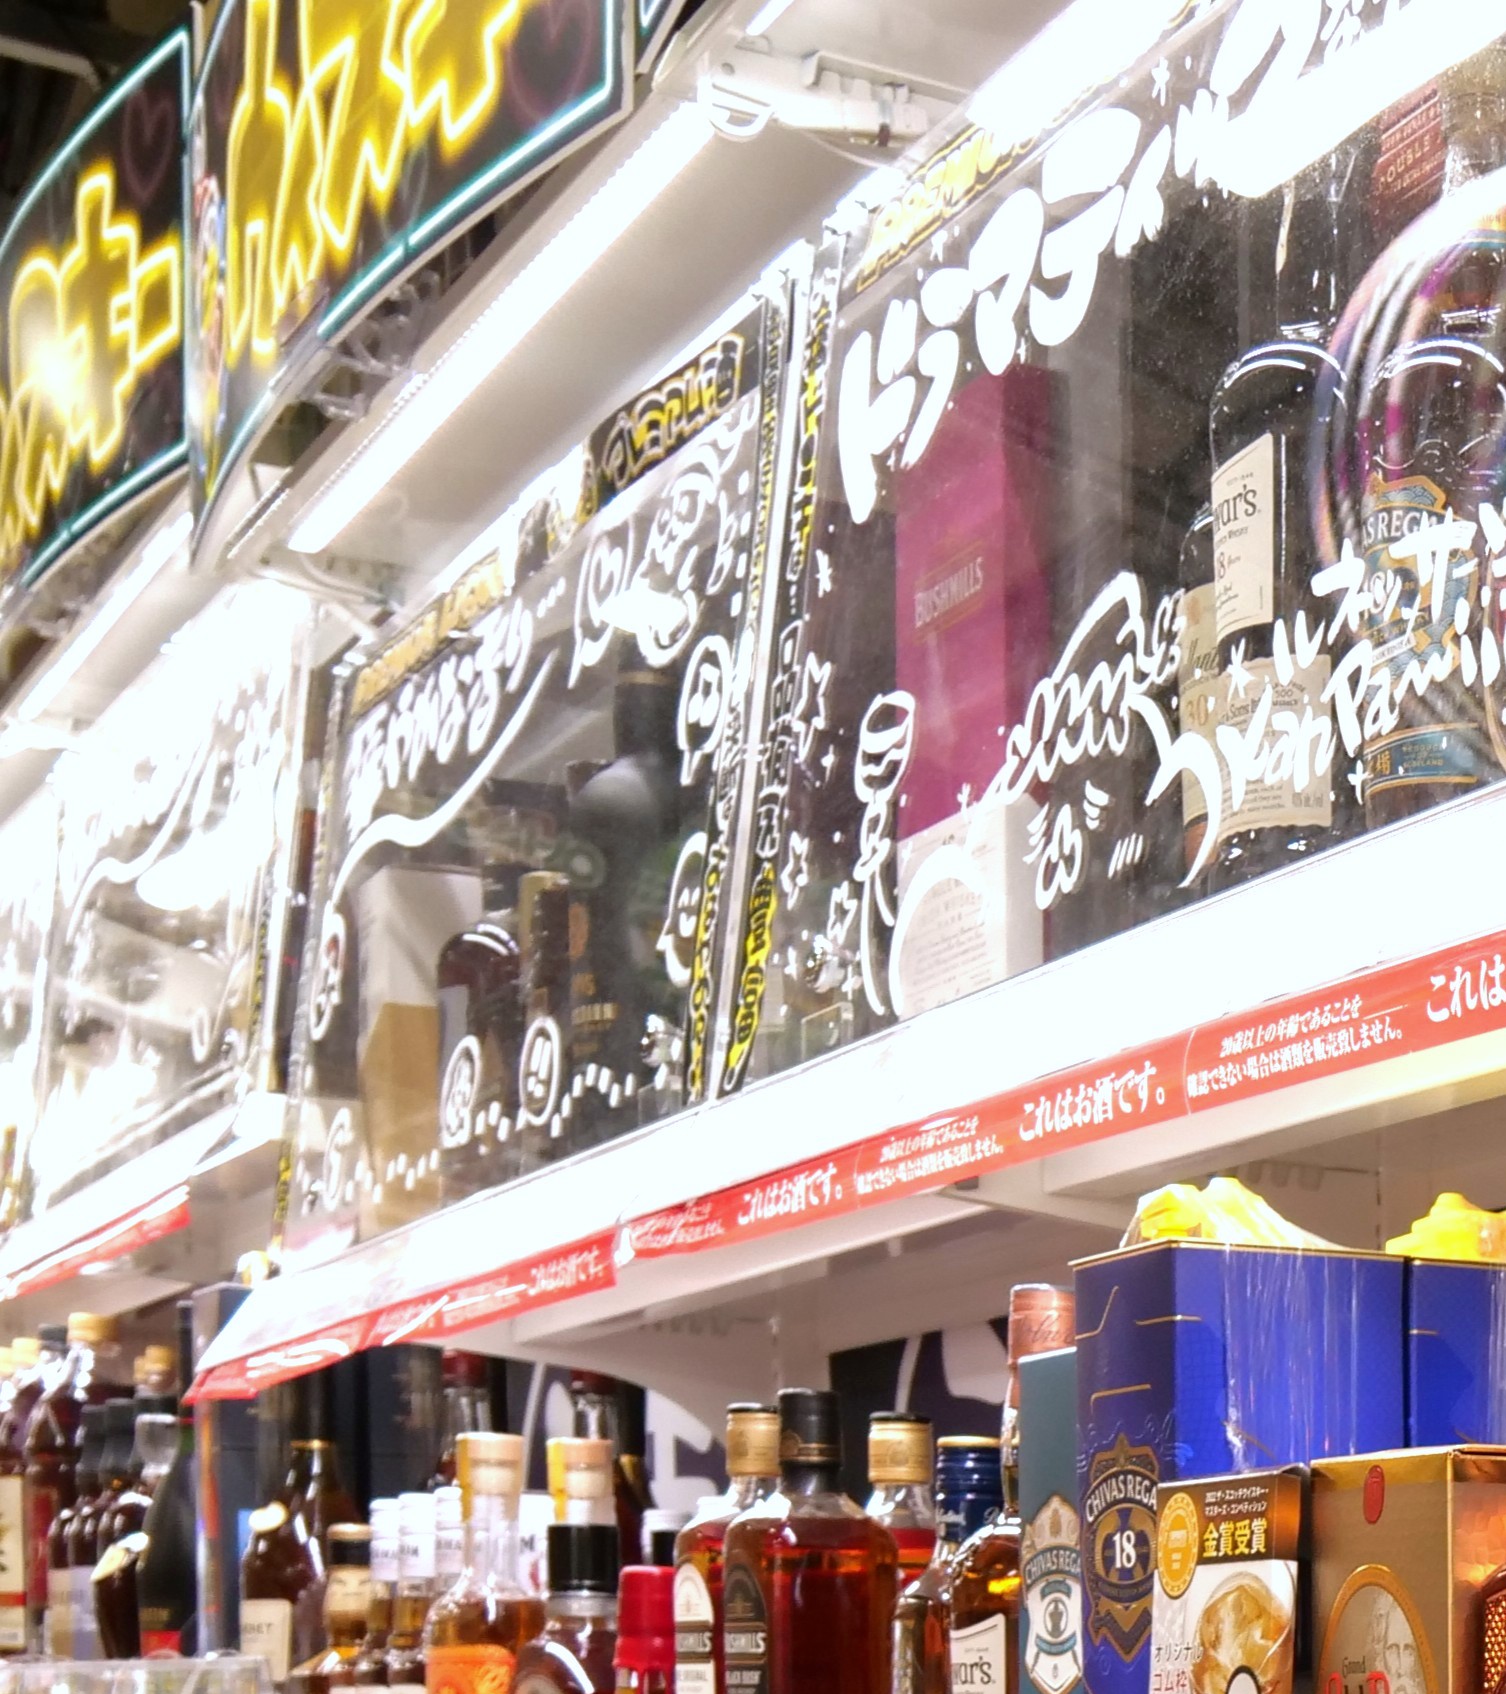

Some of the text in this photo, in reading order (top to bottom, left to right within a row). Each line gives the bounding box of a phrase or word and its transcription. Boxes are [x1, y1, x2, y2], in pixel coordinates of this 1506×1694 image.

[1018, 1062, 1167, 1141] これはお酒です。
[1112, 1530, 1137, 1570] 18
[1202, 1516, 1268, 1557] 金賞受賞
[1152, 1672, 1187, 1694] ゴム枠
